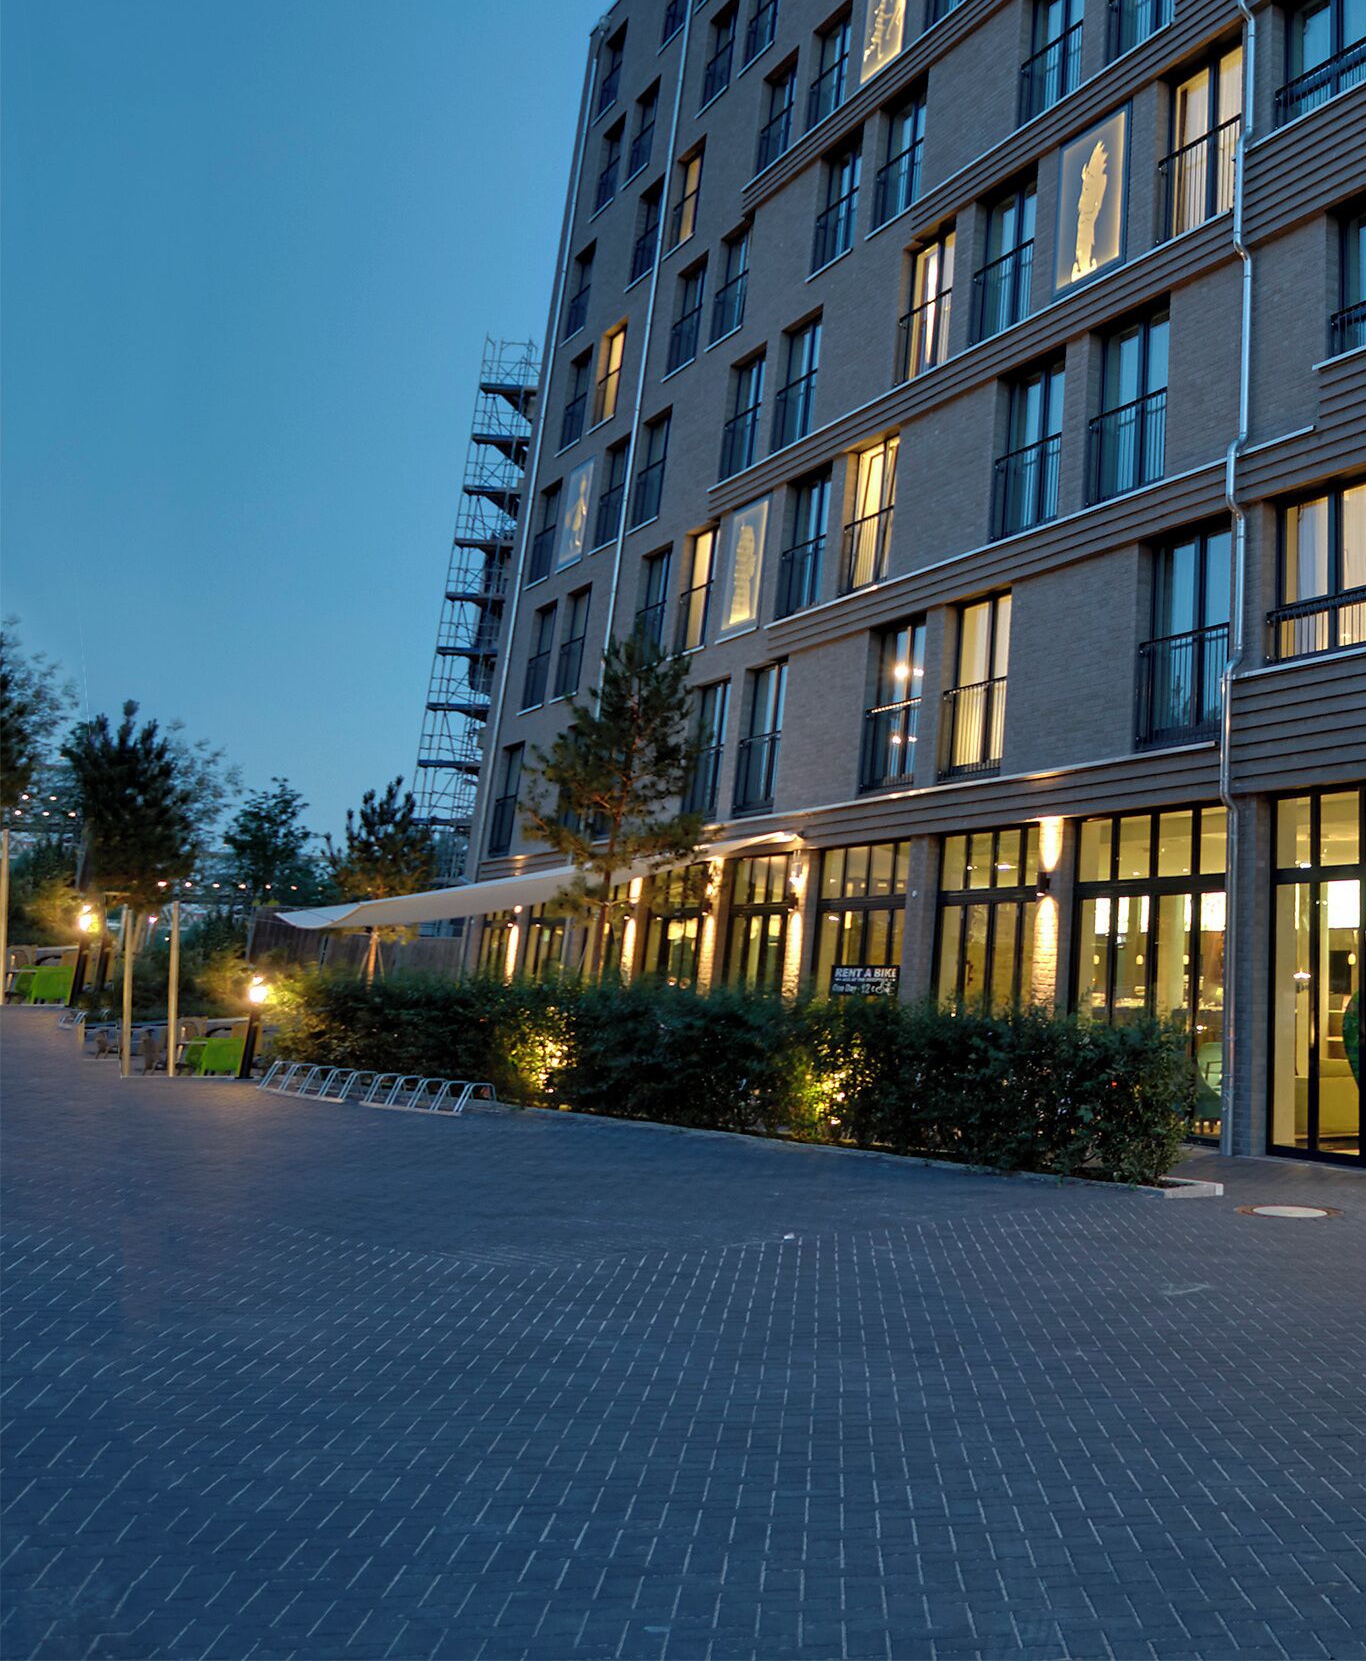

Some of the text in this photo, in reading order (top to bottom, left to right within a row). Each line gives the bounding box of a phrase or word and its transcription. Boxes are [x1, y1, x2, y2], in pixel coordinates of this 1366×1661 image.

[835, 968, 897, 977] RENT A BIKE
